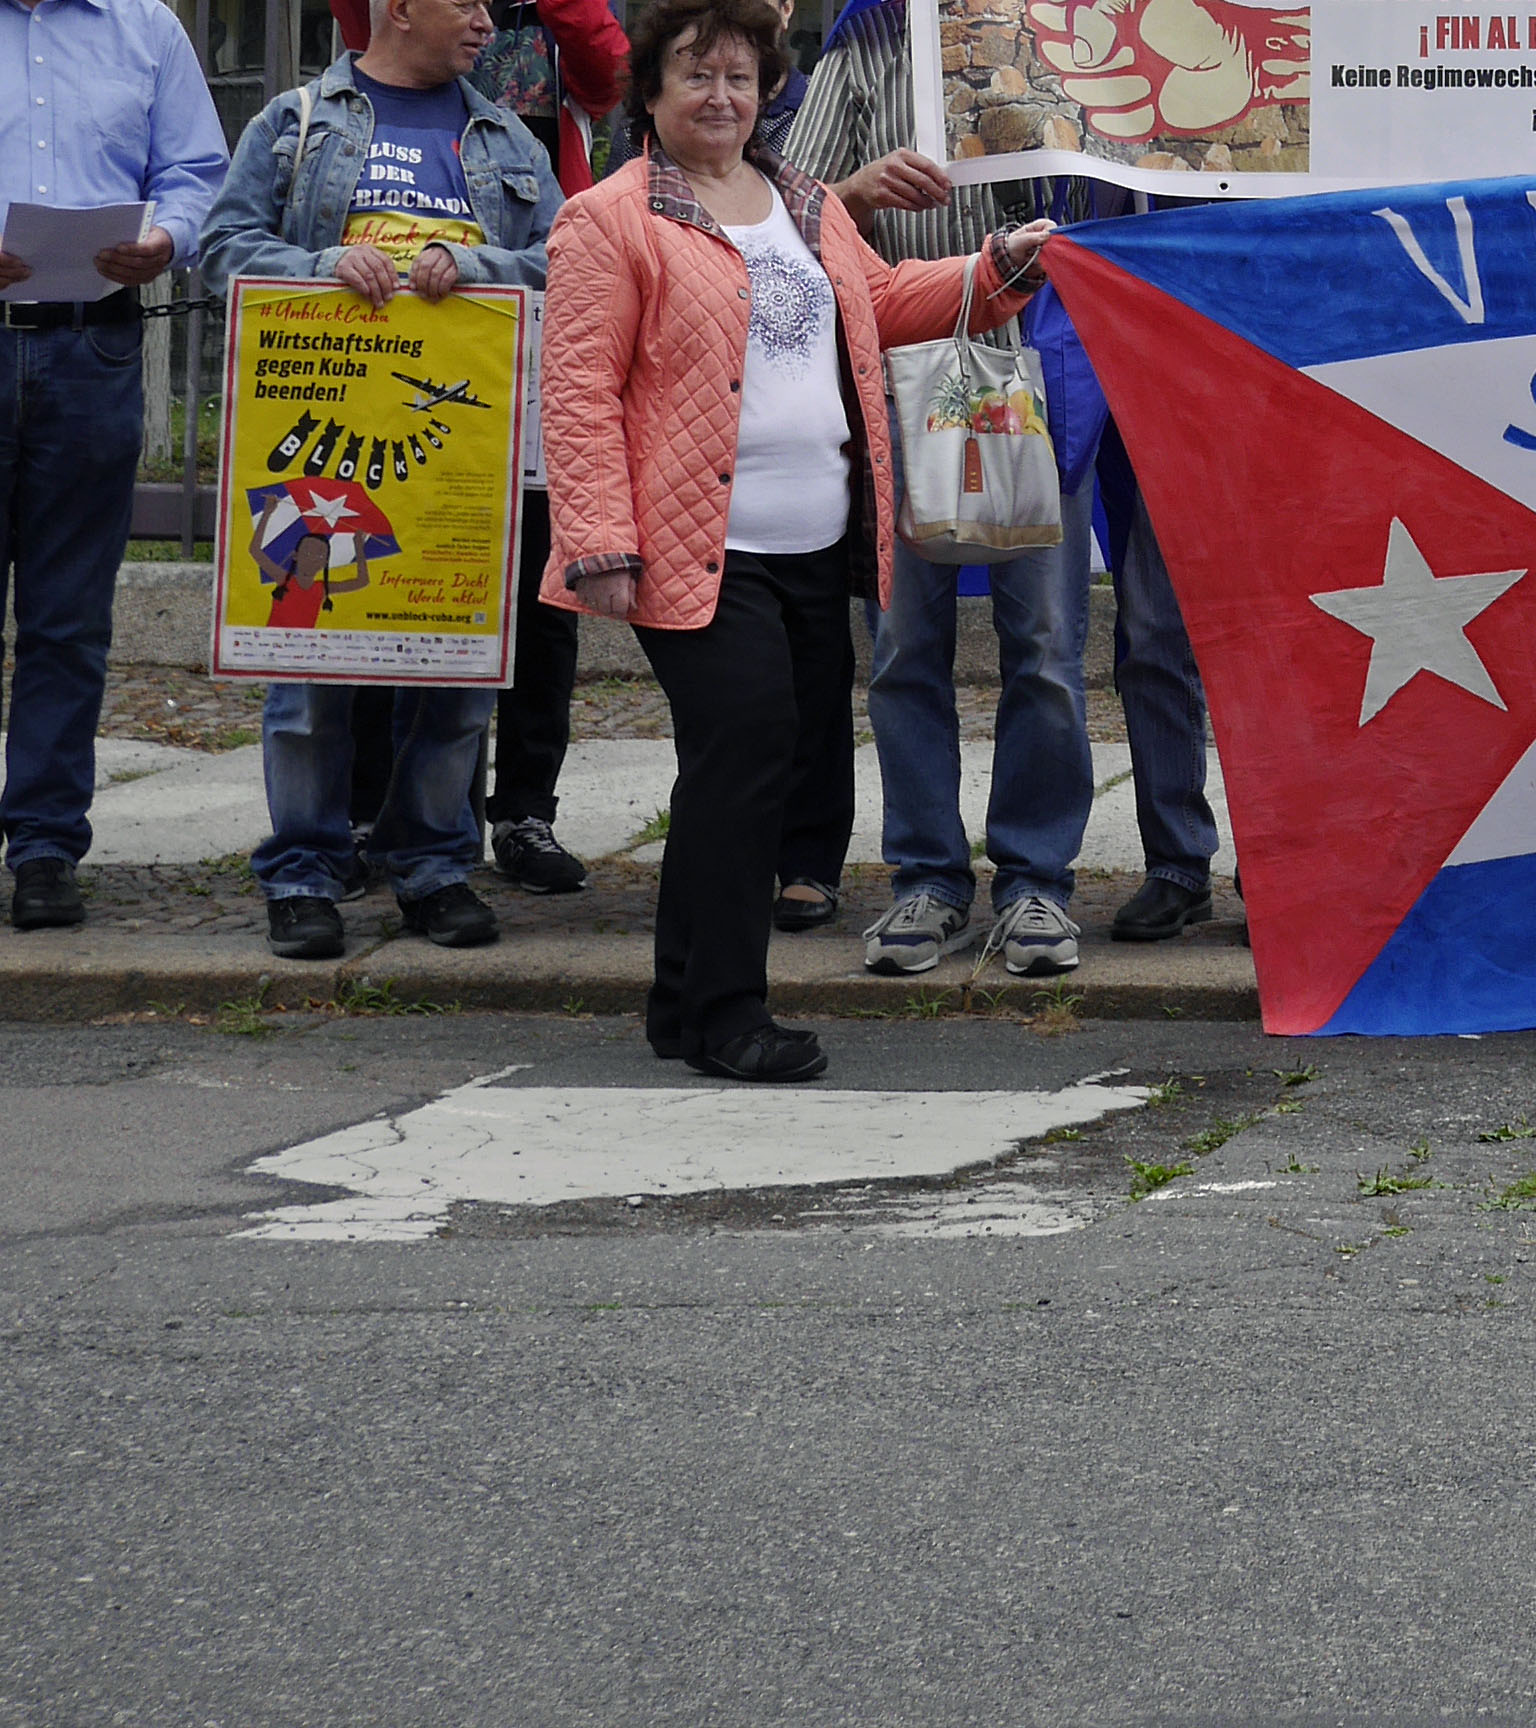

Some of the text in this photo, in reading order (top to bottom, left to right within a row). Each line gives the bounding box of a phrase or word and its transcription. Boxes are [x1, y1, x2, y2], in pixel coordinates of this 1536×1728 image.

[1486, 16, 1521, 50] AL
[1331, 64, 1391, 88] Keine
[367, 142, 422, 163] LUSS
[370, 165, 415, 185] DER
[260, 330, 423, 358] Wirtschaftskrieg
[255, 358, 367, 377] gegen Kuba
[255, 380, 347, 402] beenden!
[367, 612, 471, 624] www.unblock-cuba.org
